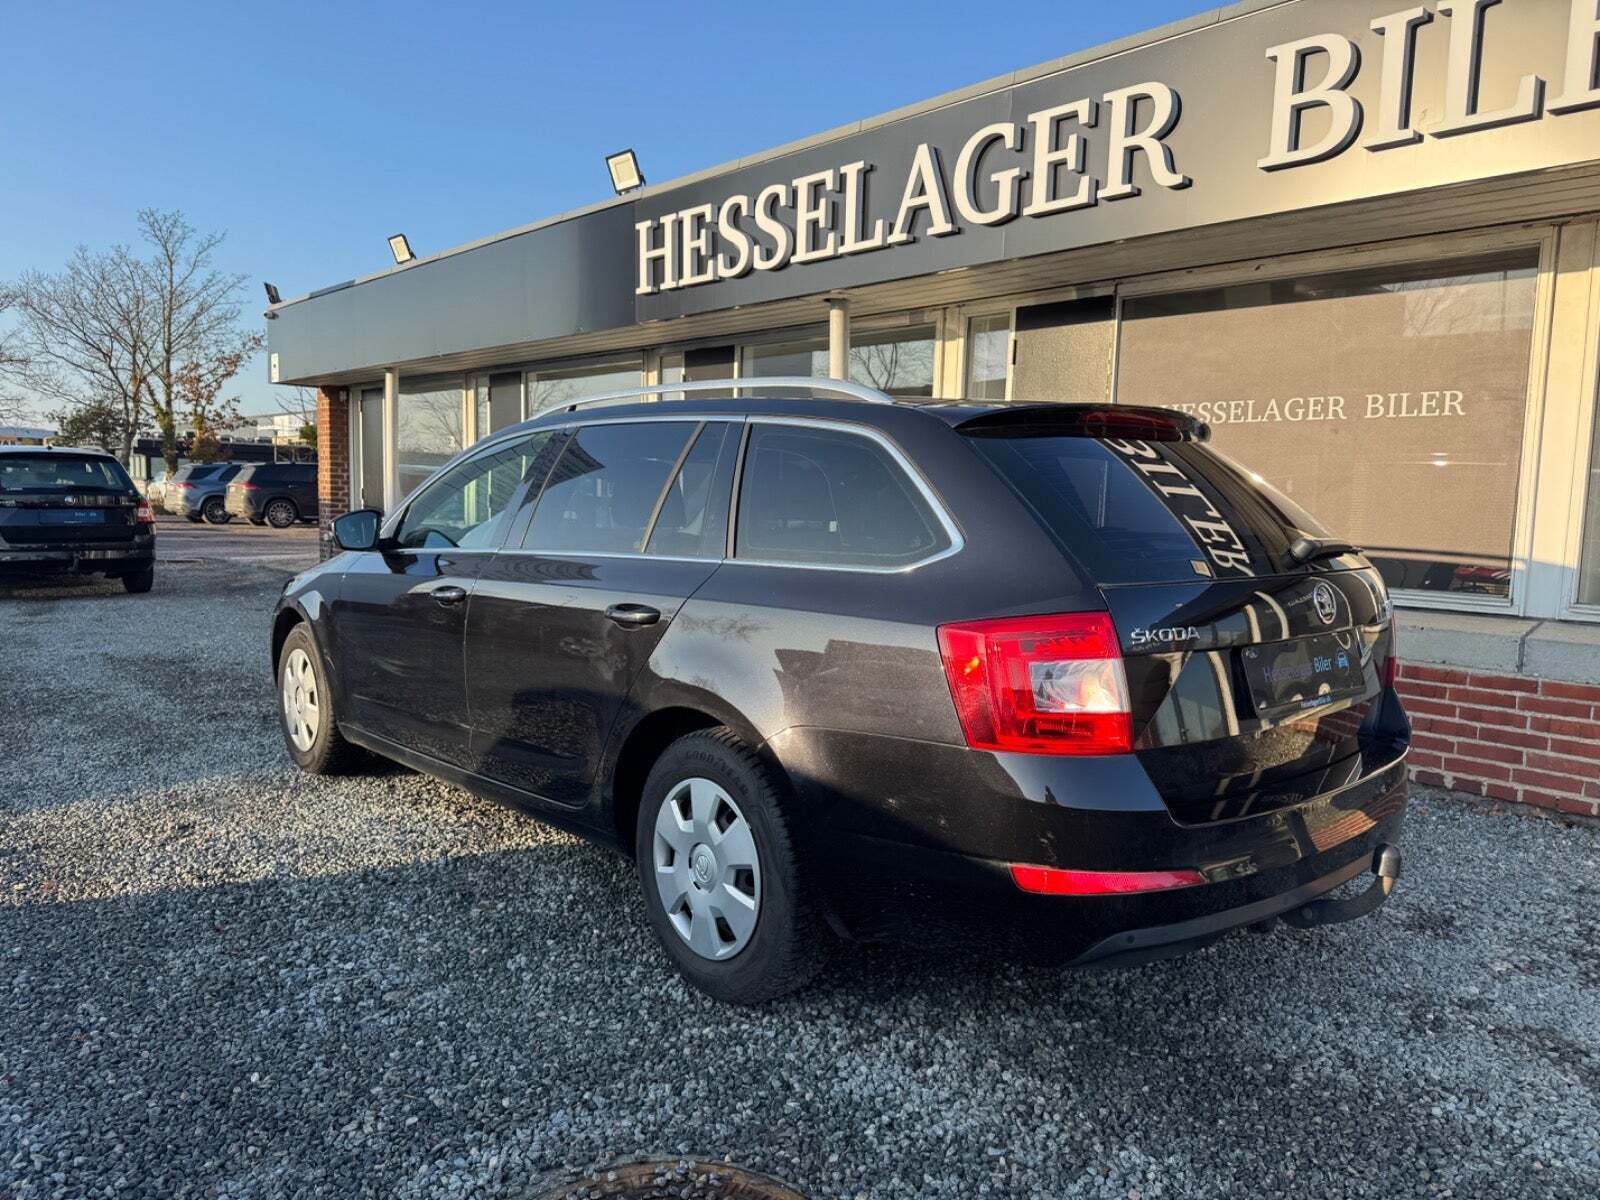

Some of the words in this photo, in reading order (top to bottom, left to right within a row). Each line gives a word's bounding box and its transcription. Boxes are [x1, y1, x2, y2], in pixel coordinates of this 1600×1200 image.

[634, 82, 1191, 295] HESSELAGER
[1160, 396, 1347, 425] ESSELAGER
[1364, 390, 1466, 419] BILER
[1130, 625, 1201, 645] ŠKODA
[1313, 655, 1332, 673] Biler
